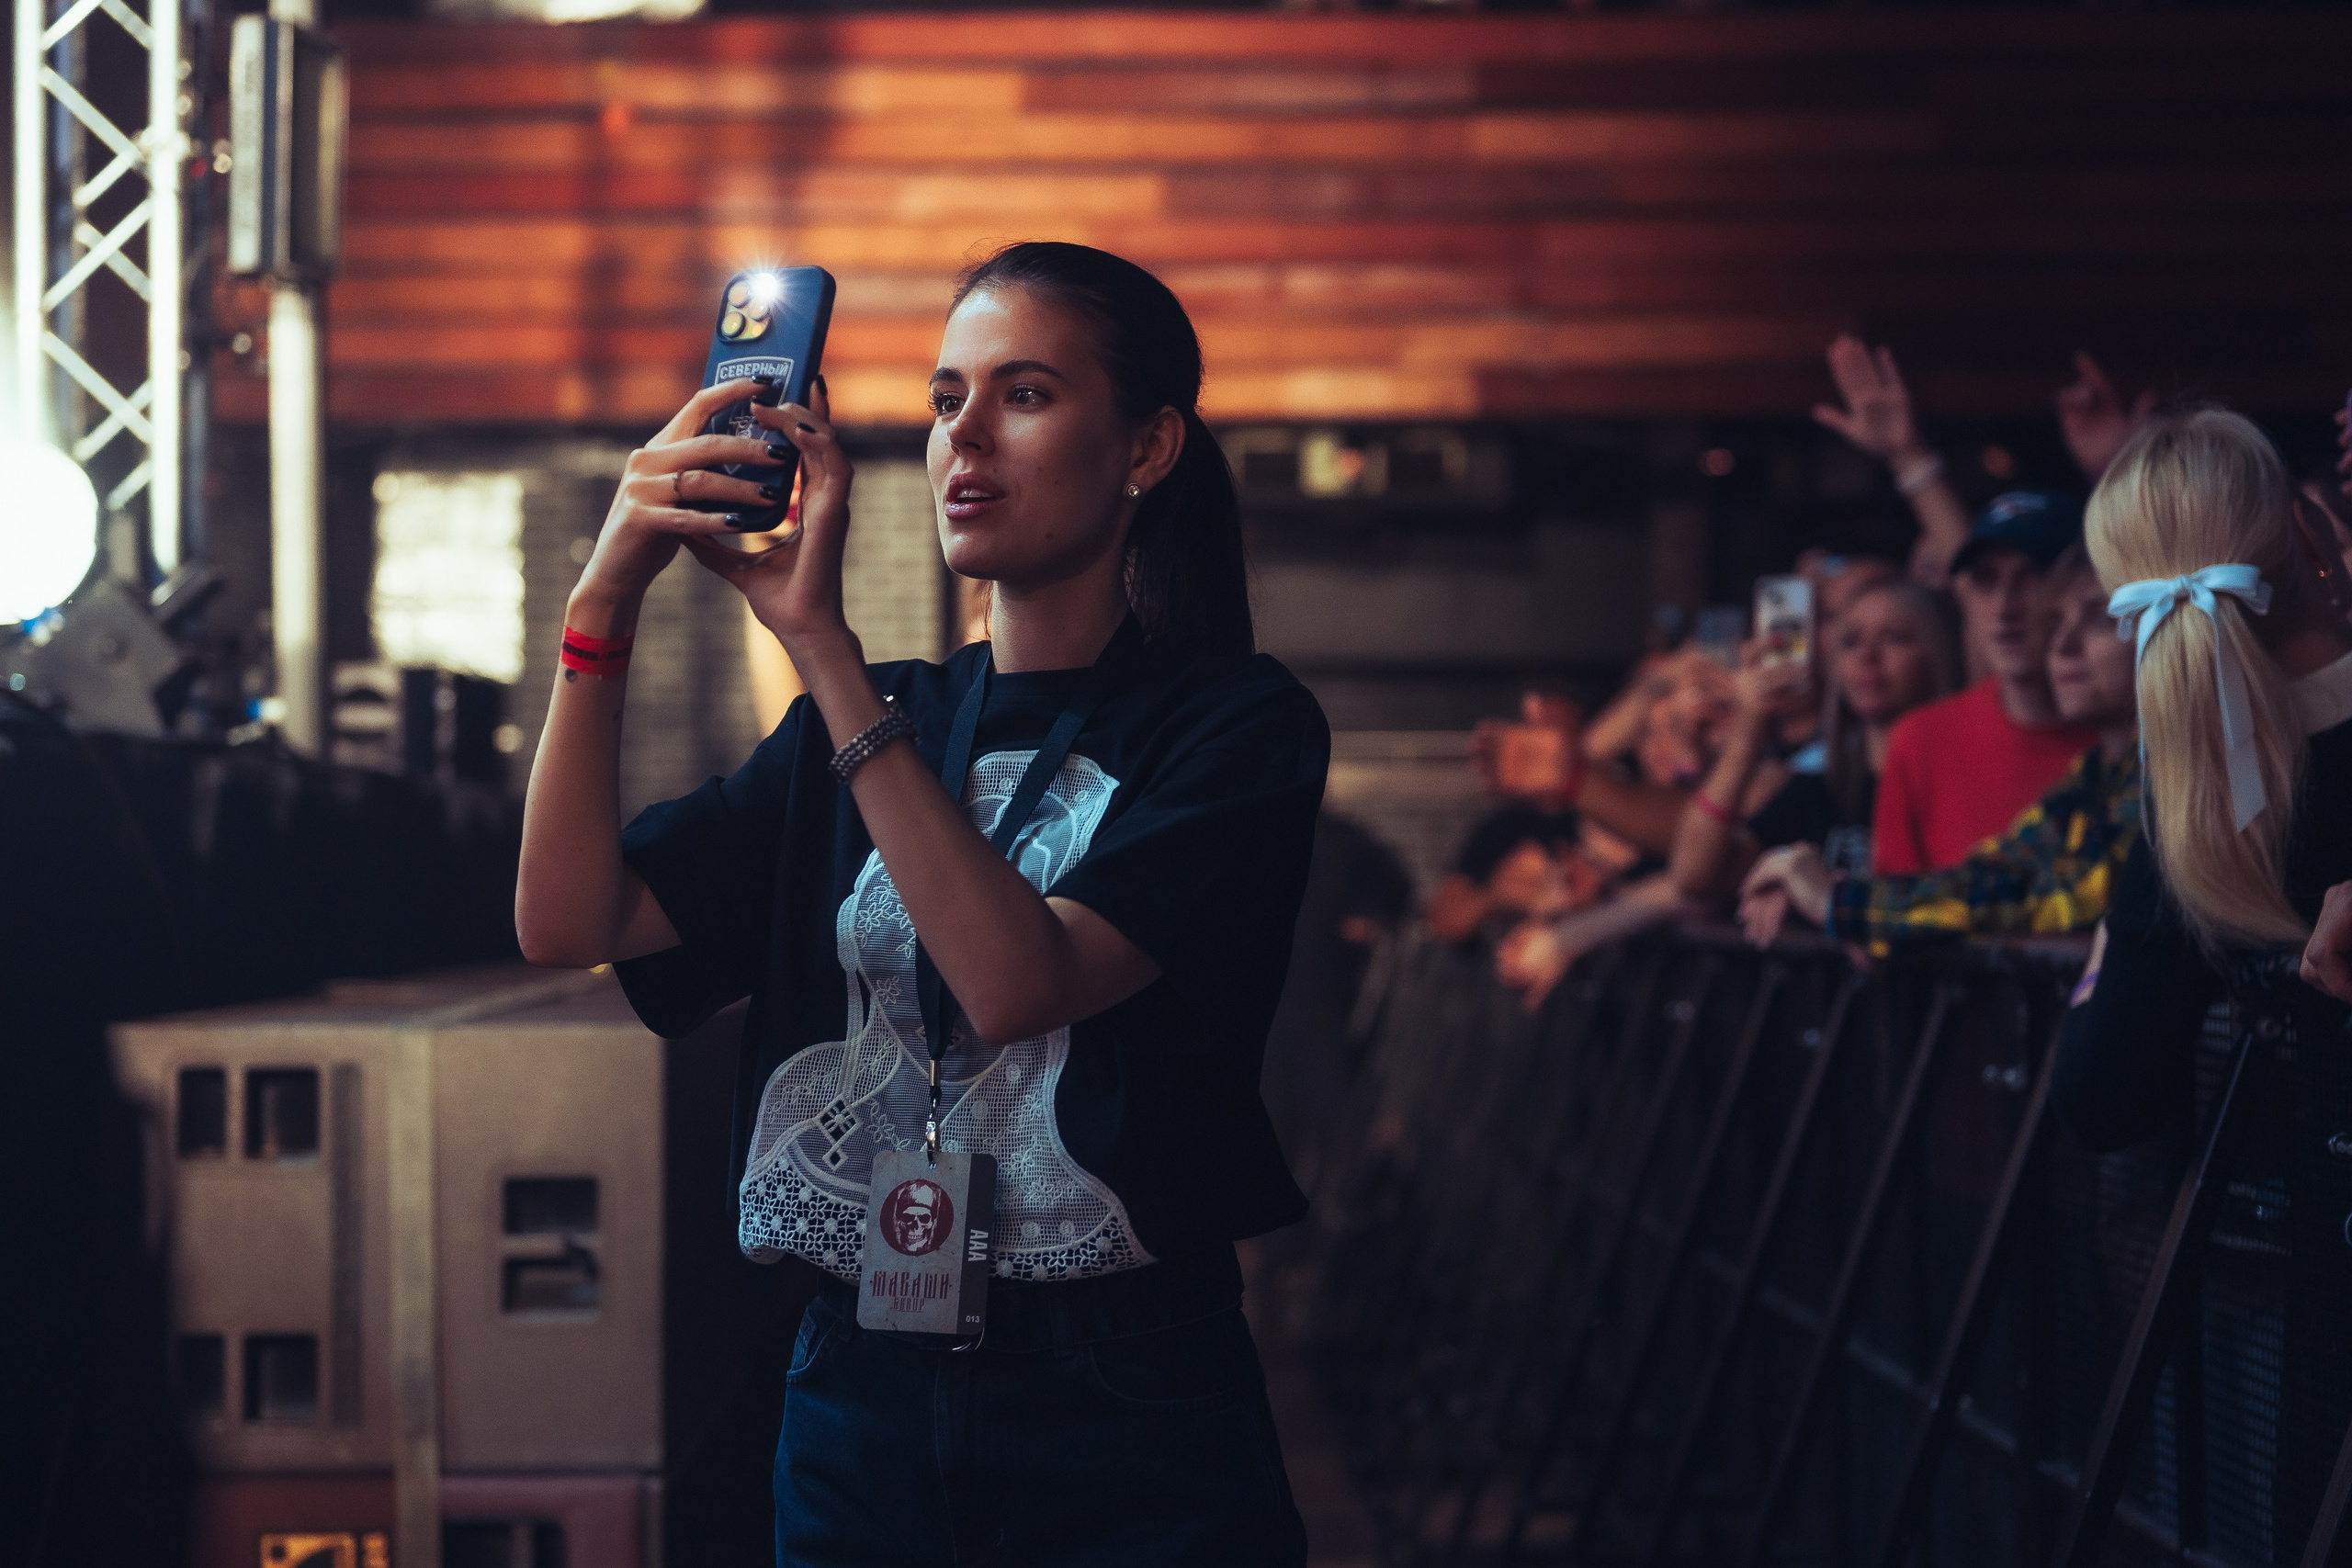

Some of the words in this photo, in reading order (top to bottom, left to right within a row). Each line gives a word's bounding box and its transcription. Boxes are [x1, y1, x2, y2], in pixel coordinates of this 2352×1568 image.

[719, 362, 789, 379] СЕВЕРНЫЙ
[967, 1229, 989, 1262] AAA
[872, 1270, 950, 1299] МАВАШИ
[966, 1314, 979, 1323] 013
